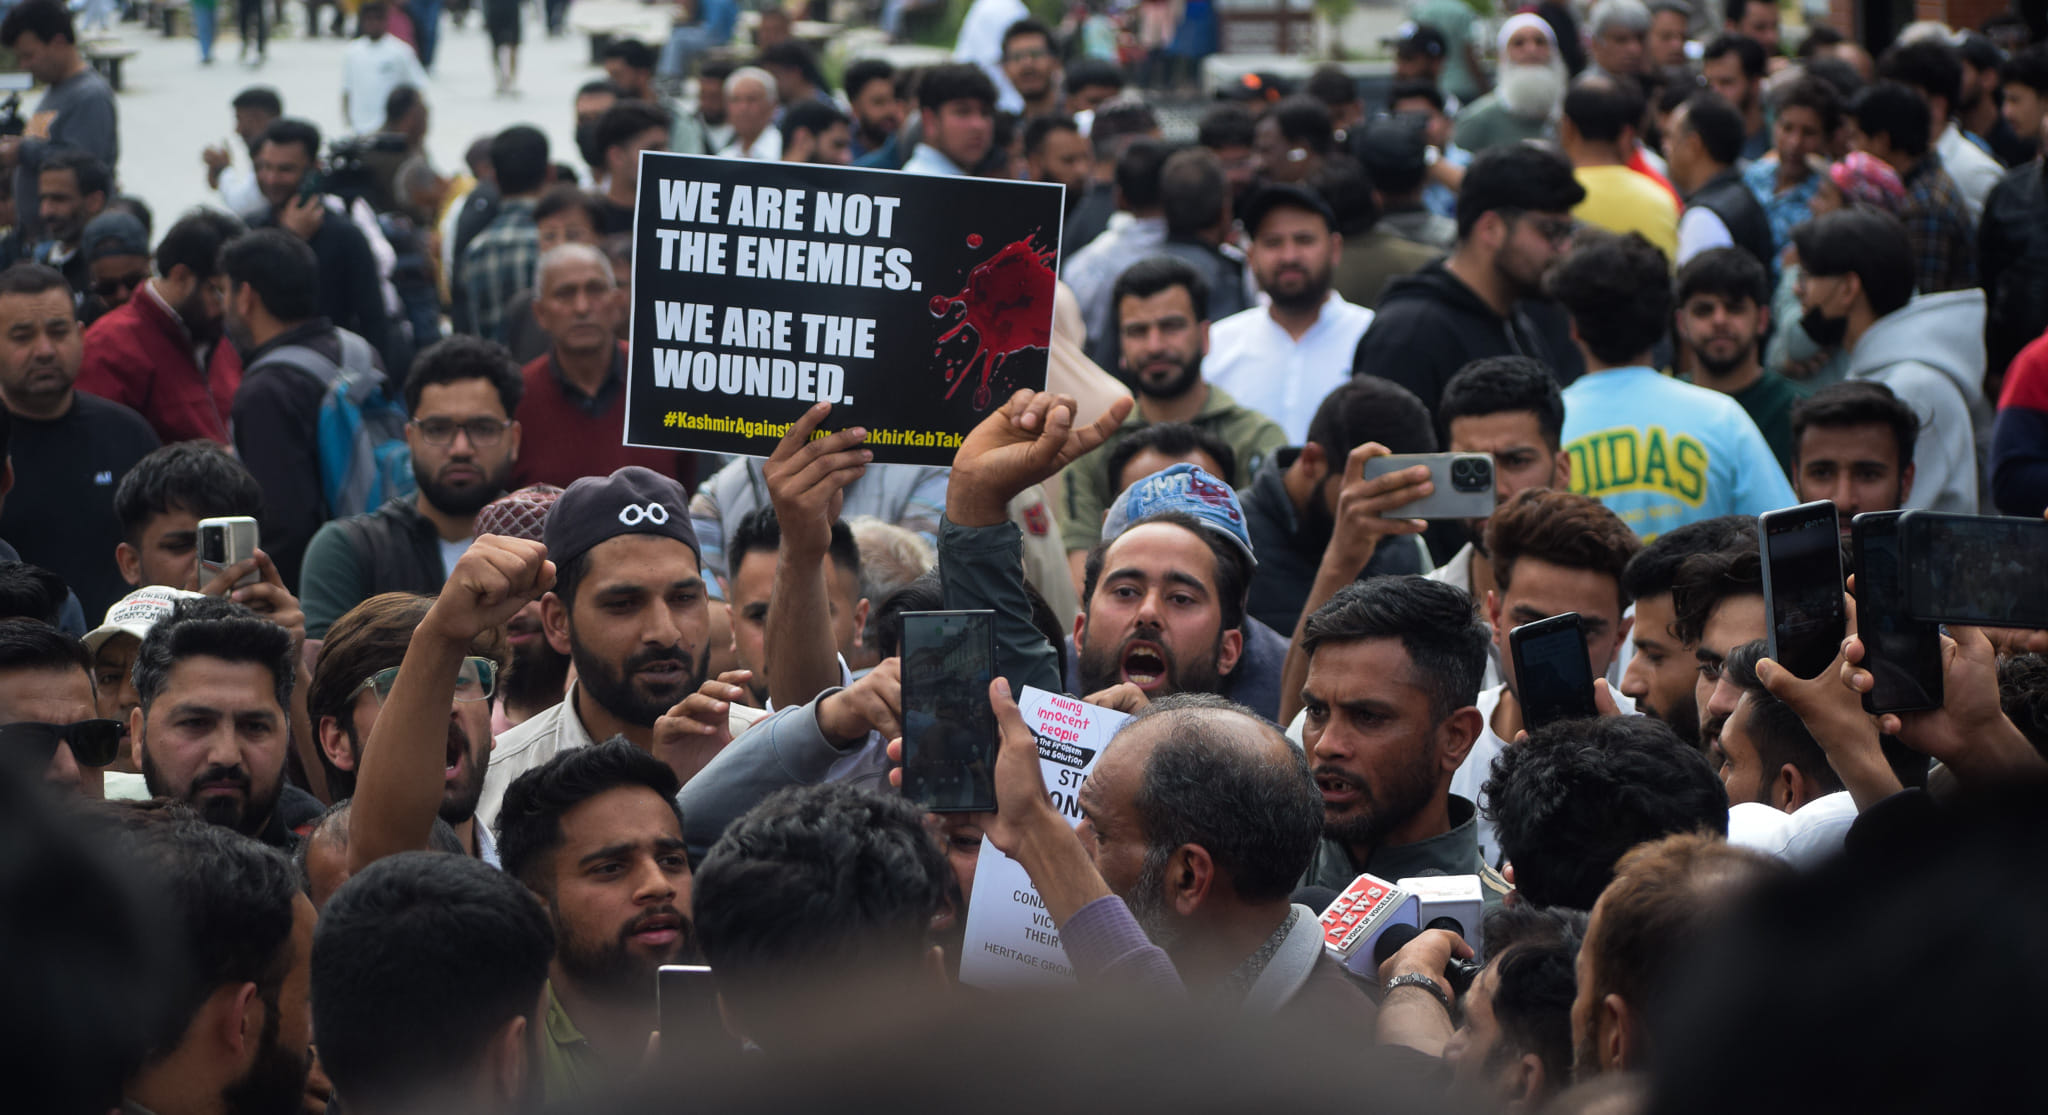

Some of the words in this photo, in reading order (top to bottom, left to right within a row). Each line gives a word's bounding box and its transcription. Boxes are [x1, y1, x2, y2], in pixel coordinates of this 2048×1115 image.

[659, 179, 721, 224] WE
[726, 184, 806, 231] ARE
[813, 191, 901, 238] NOT
[656, 229, 728, 275] THE
[735, 235, 922, 292] ENEMIES.
[654, 301, 714, 344] WE
[720, 306, 793, 352] ARE
[801, 313, 877, 359] THE
[652, 348, 854, 405] WOUNDED.
[1024, 926, 1059, 949] THEIR
[1328, 886, 1383, 939] NEWS
[1346, 925, 1363, 941] VOICE
[1362, 917, 1371, 926] OF
[1369, 889, 1399, 918] VOICELESS
[984, 941, 1039, 968] HERITAGE
